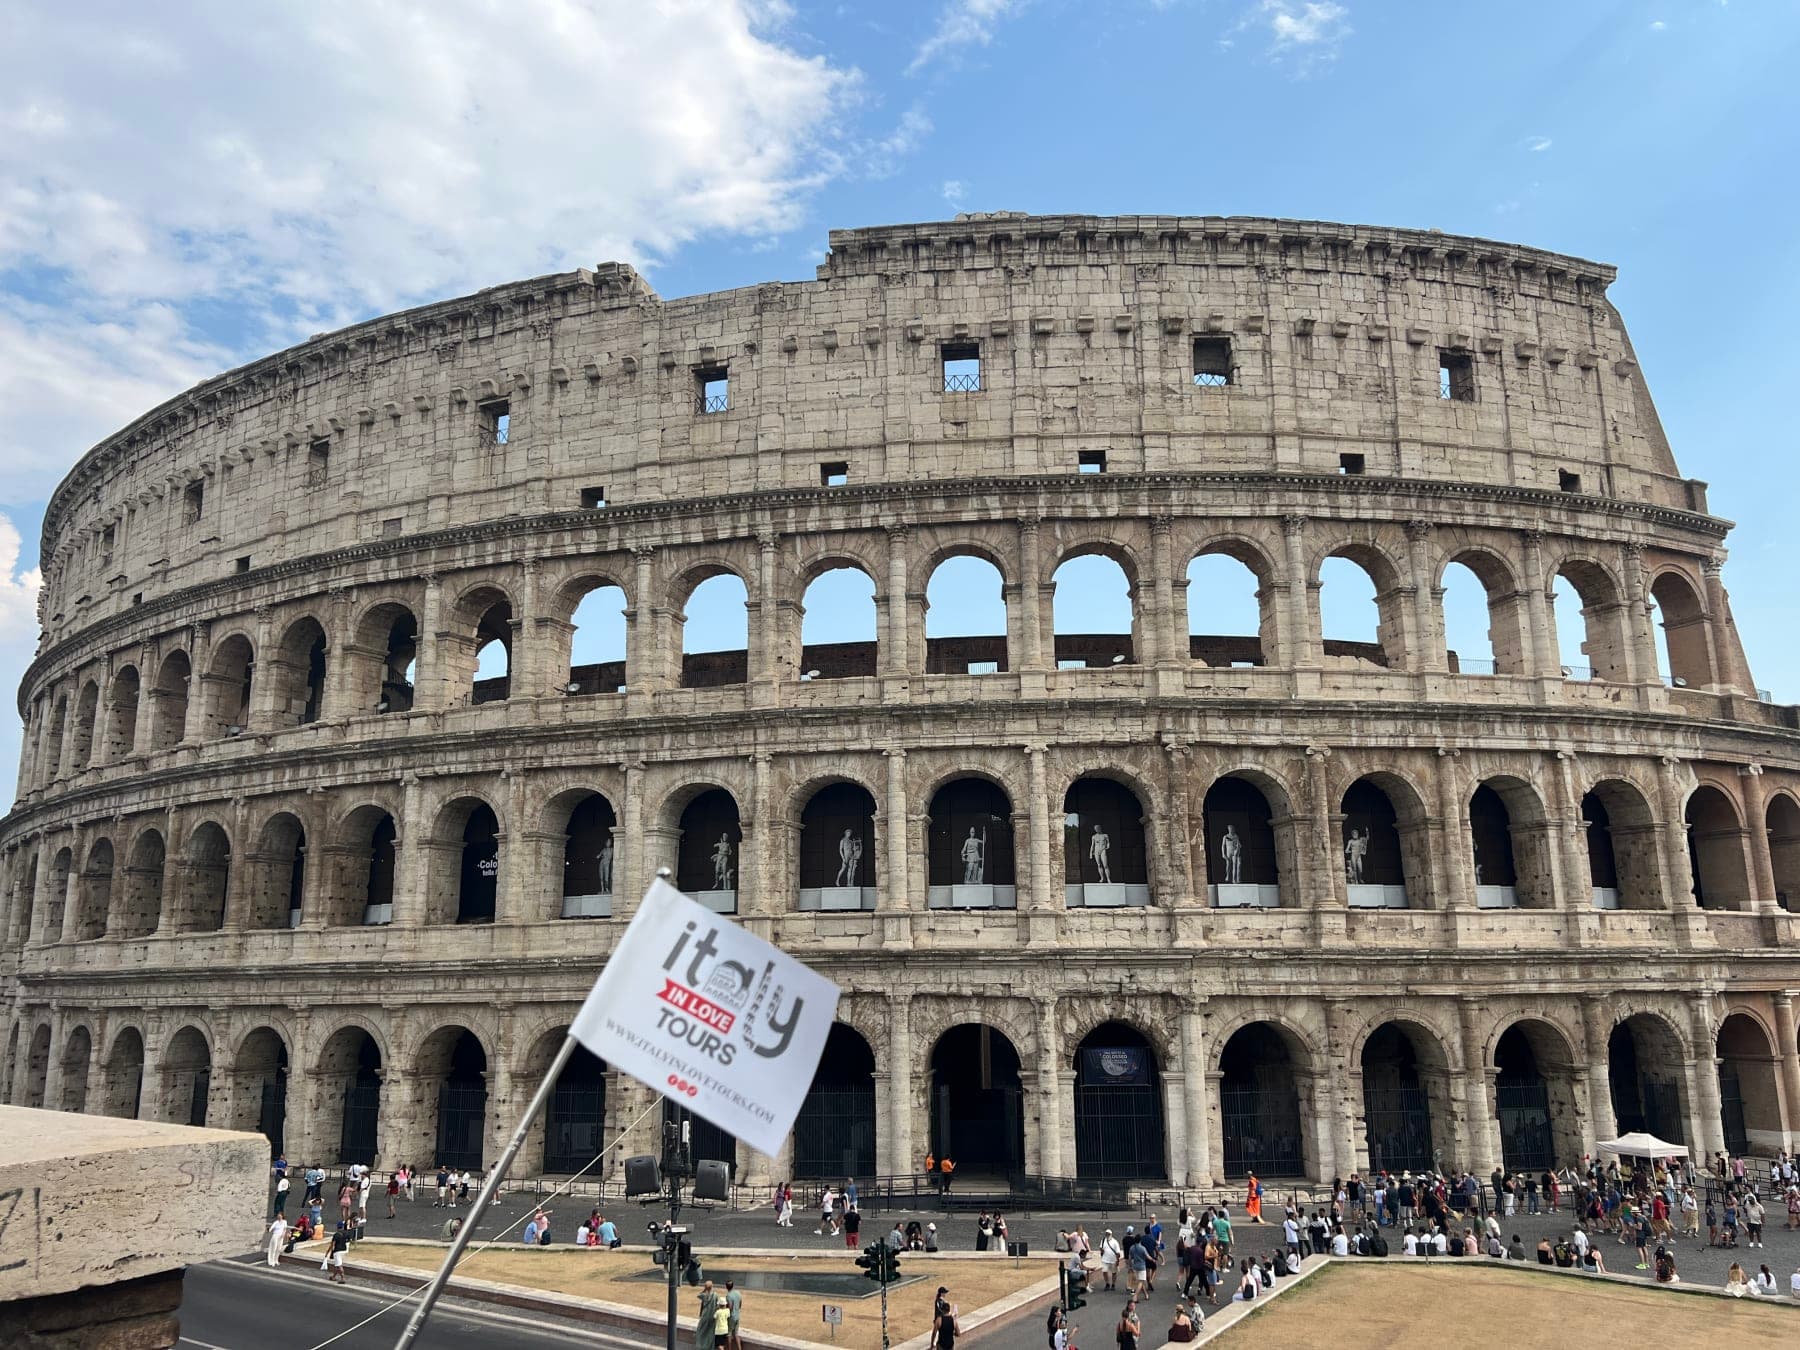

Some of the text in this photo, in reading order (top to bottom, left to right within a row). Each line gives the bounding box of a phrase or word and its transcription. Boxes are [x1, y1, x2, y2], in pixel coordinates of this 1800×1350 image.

[662, 920, 804, 1059] italy
[667, 986, 733, 1032] IN LOVE
[606, 1018, 775, 1125] WWW.ITALYINLOVETOURS.COM
[656, 1008, 736, 1066] TOURS
